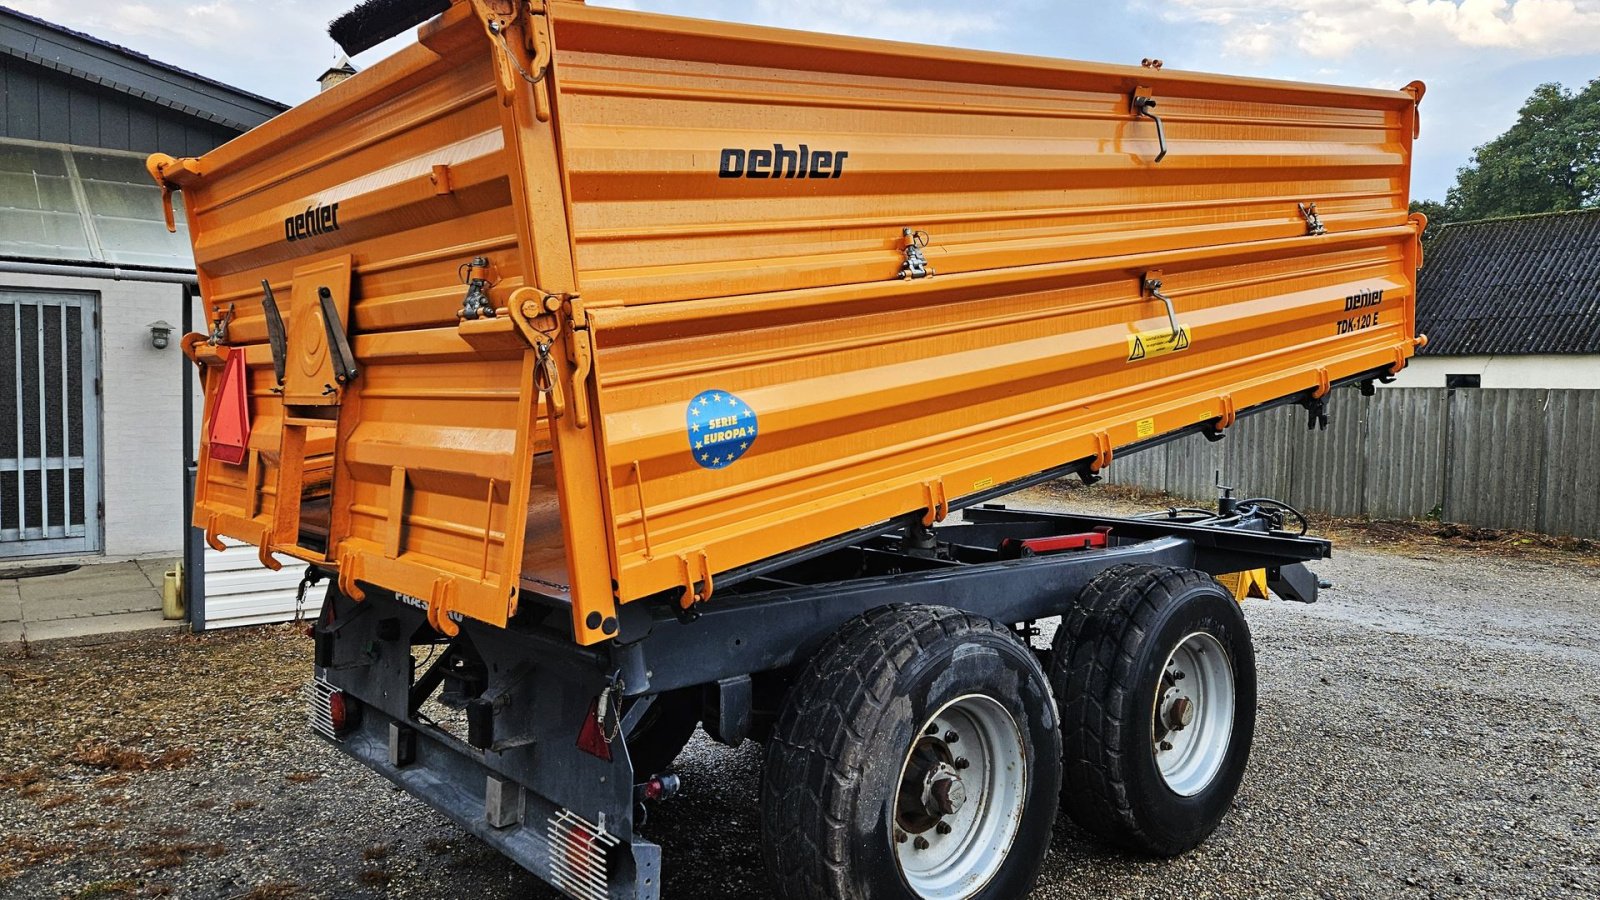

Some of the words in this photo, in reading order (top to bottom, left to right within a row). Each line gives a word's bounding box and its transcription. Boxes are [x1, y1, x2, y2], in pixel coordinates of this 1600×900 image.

[718, 143, 849, 179] oehler
[285, 202, 340, 242] oehler
[1344, 288, 1384, 312] oehler
[1372, 312, 1379, 326] E
[708, 415, 738, 430] SERIE
[703, 427, 747, 445] EUROPA
